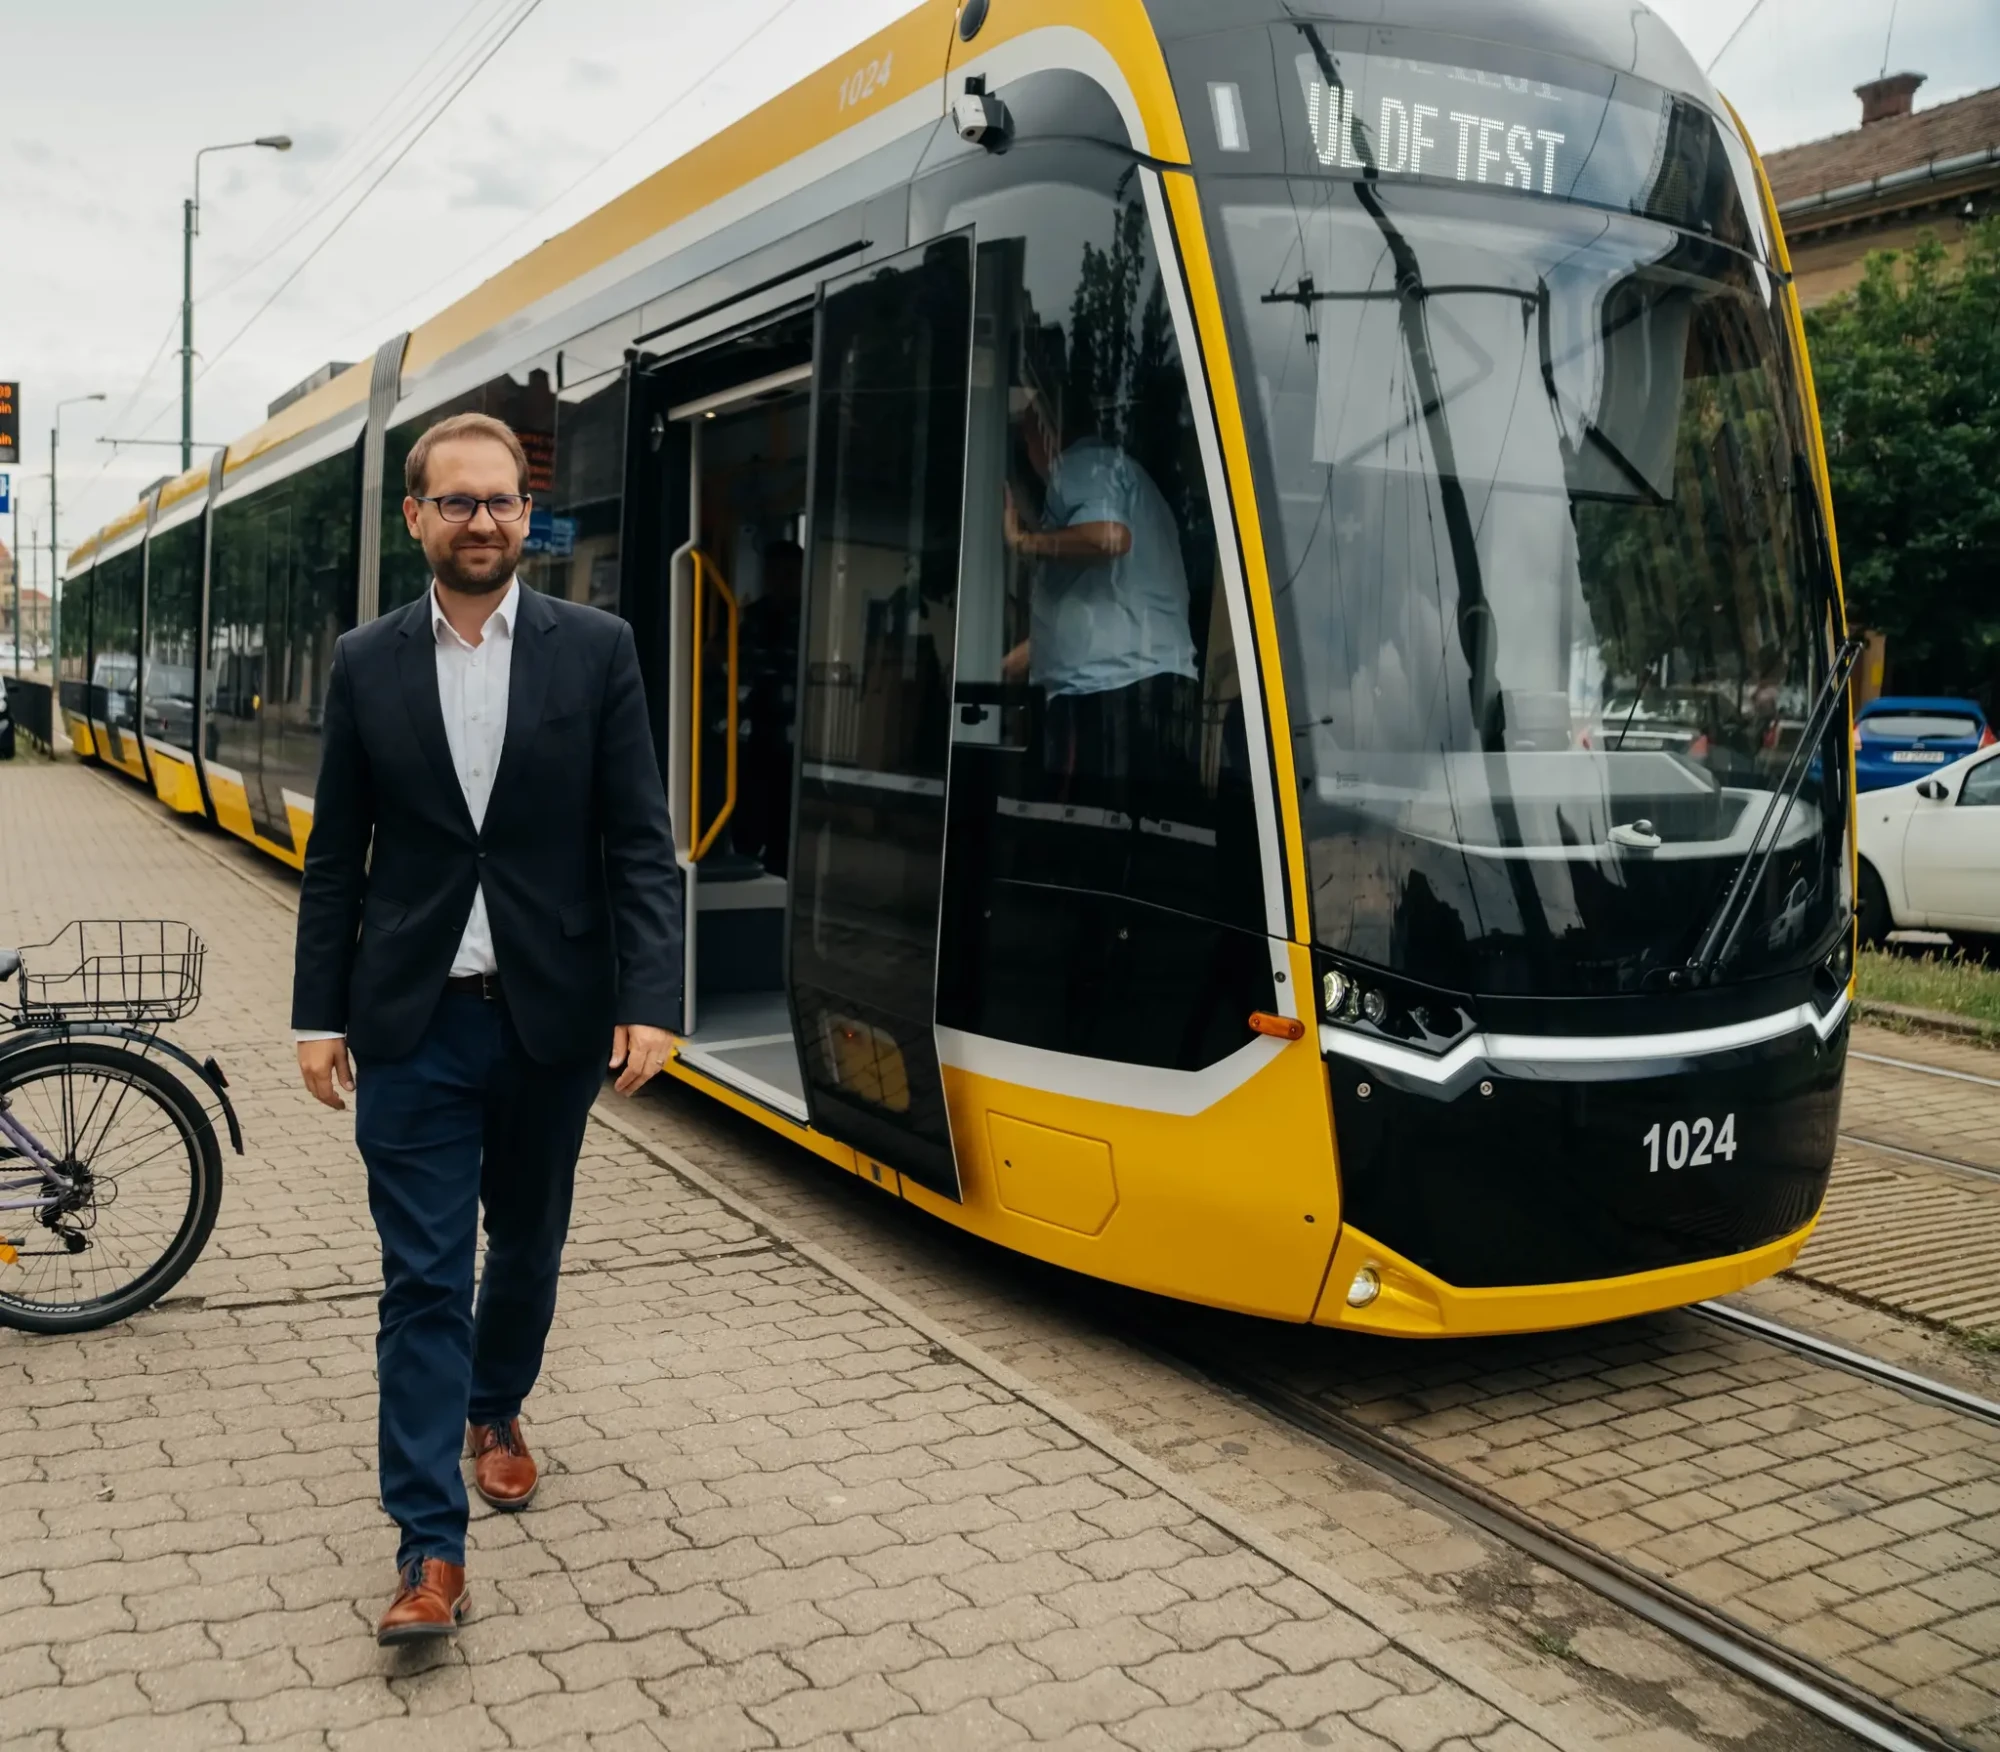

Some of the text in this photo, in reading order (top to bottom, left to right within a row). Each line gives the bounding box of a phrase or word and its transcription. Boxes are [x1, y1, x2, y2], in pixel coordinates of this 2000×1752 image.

[839, 50, 893, 112] 1024
[1643, 1113, 1737, 1172] 1024
[0, 1294, 81, 1312] WARRIOR
